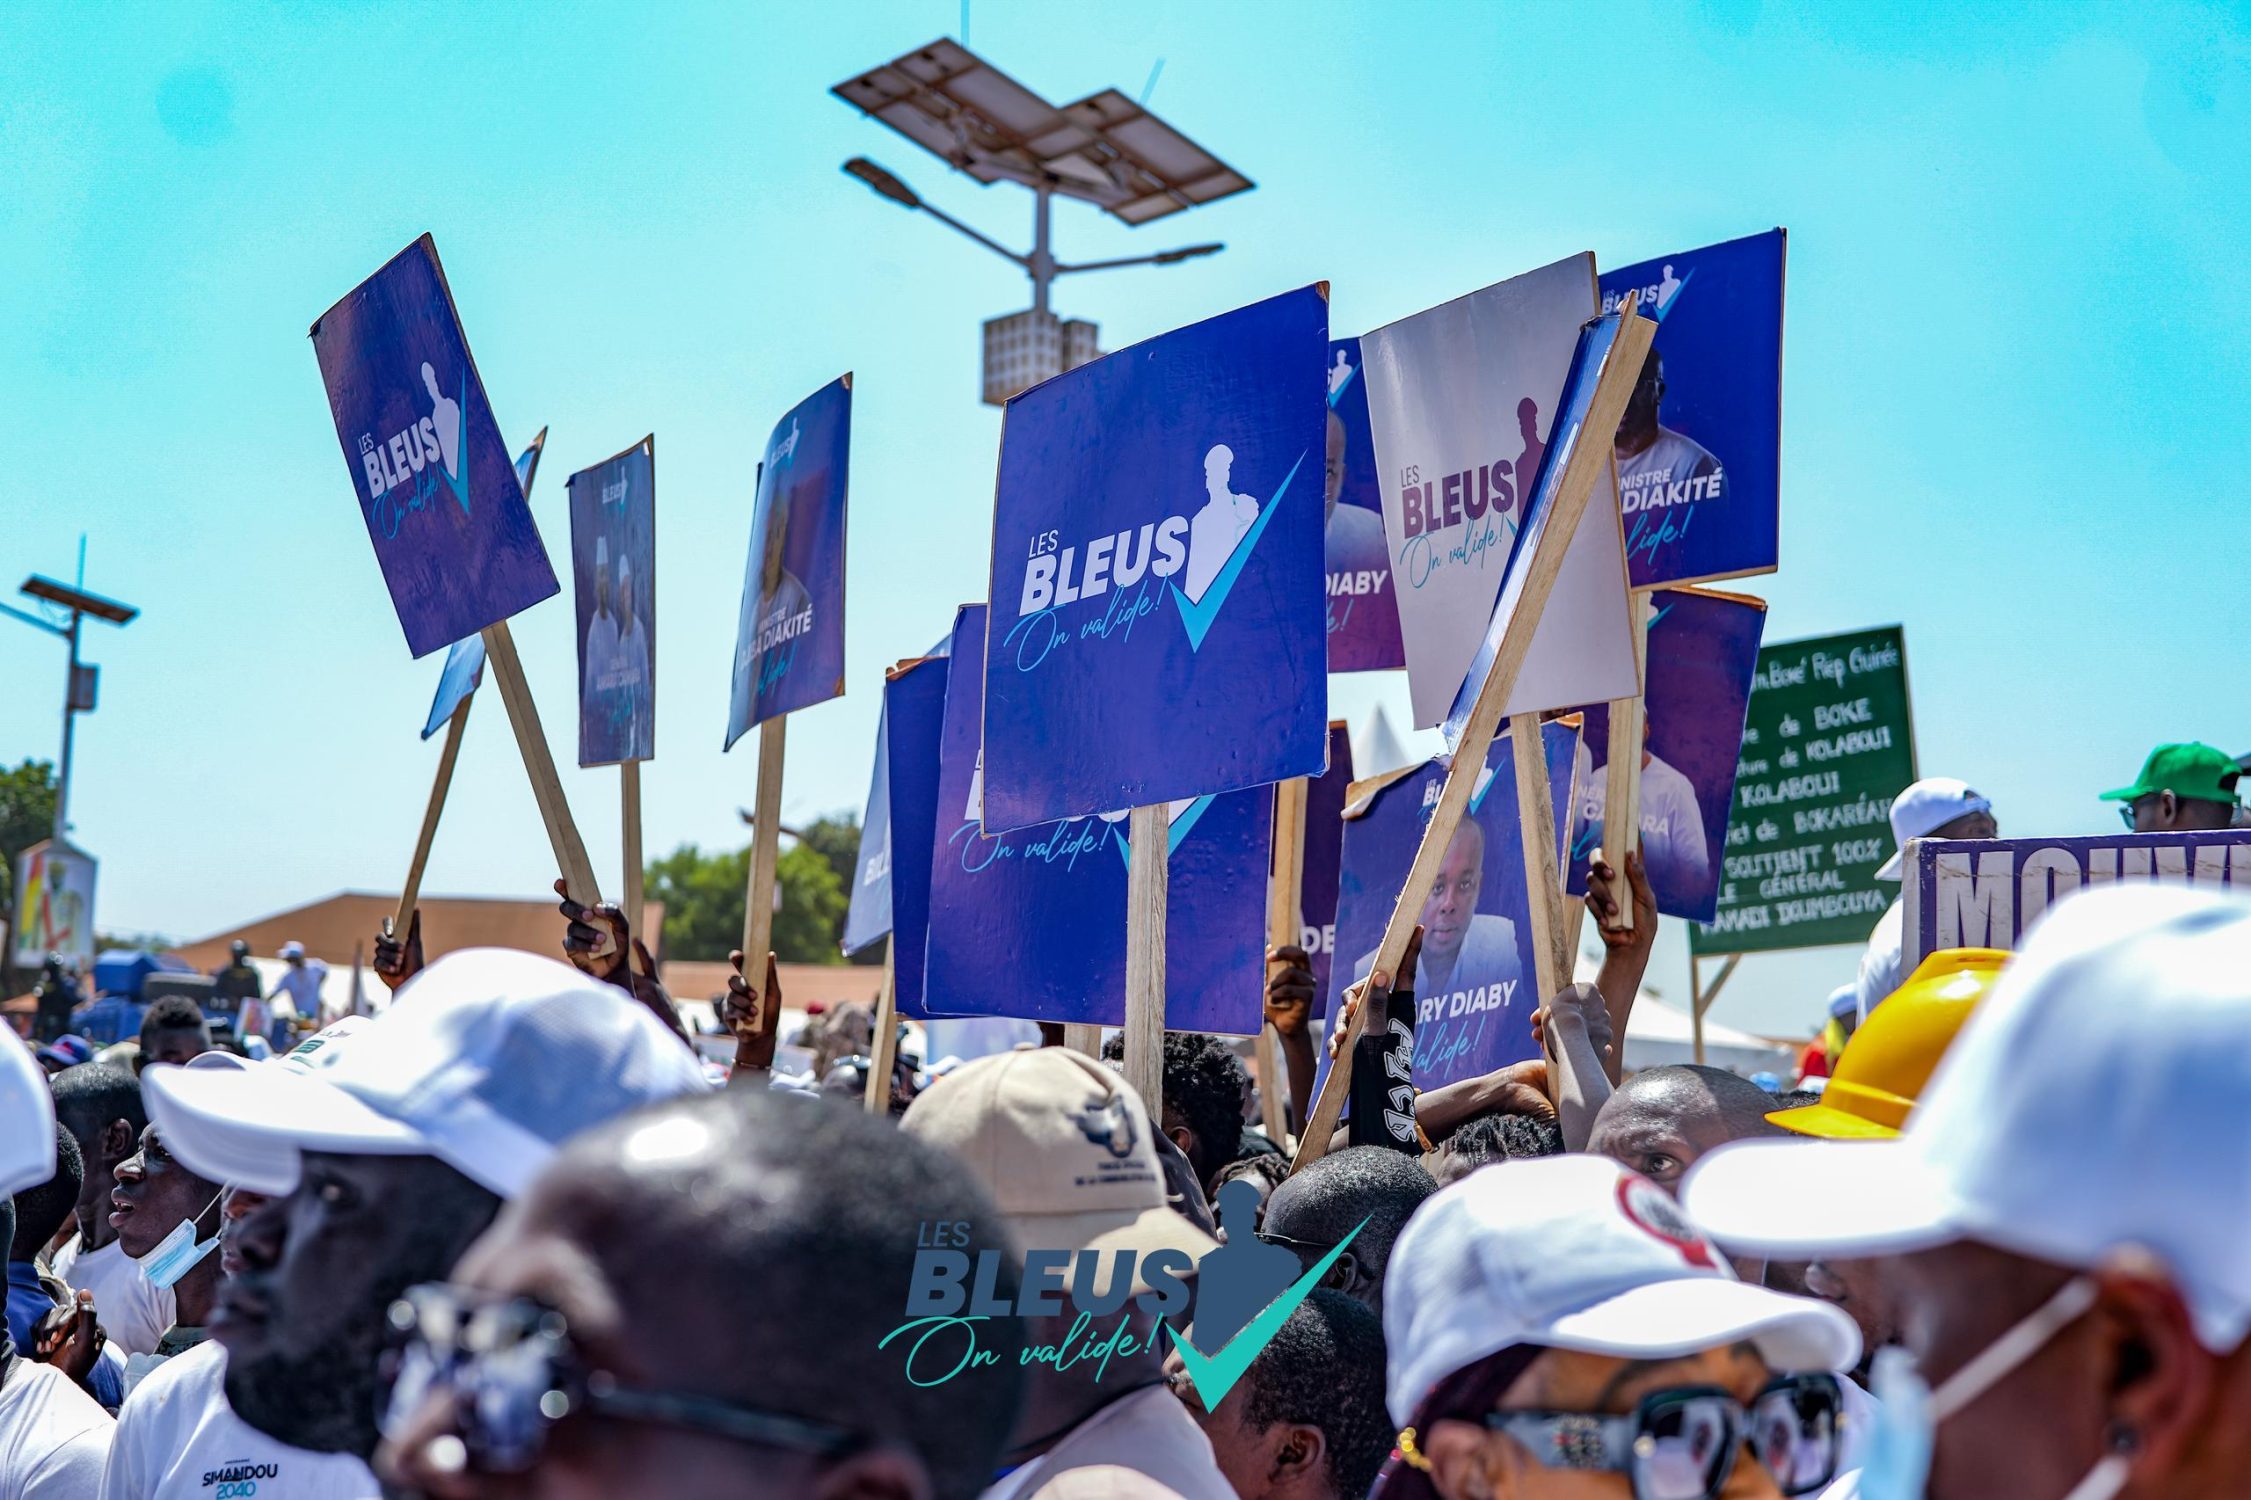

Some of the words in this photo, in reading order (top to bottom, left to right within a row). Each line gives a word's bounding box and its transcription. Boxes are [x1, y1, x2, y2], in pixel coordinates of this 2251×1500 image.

[358, 431, 375, 456] LES
[362, 416, 441, 500] BLEUS
[1400, 464, 1420, 488] LES
[1402, 459, 1515, 540] BLEUS
[1617, 468, 1672, 491] NISTRE
[1622, 466, 1723, 514] DIAKITÉ
[1029, 529, 1059, 559] LES
[1399, 531, 1442, 589] On
[1448, 509, 1505, 571] valide!
[1626, 504, 1695, 566] lide!
[1019, 515, 1189, 617] BLEUS
[1003, 604, 1070, 672] On
[1081, 572, 1170, 643] valide!
[948, 820, 1015, 873] On
[1024, 818, 1115, 873] valide!
[1449, 979, 1518, 1019] DIABY
[202, 1463, 278, 1487] SIMANDOU
[216, 1480, 257, 1500] 2040
